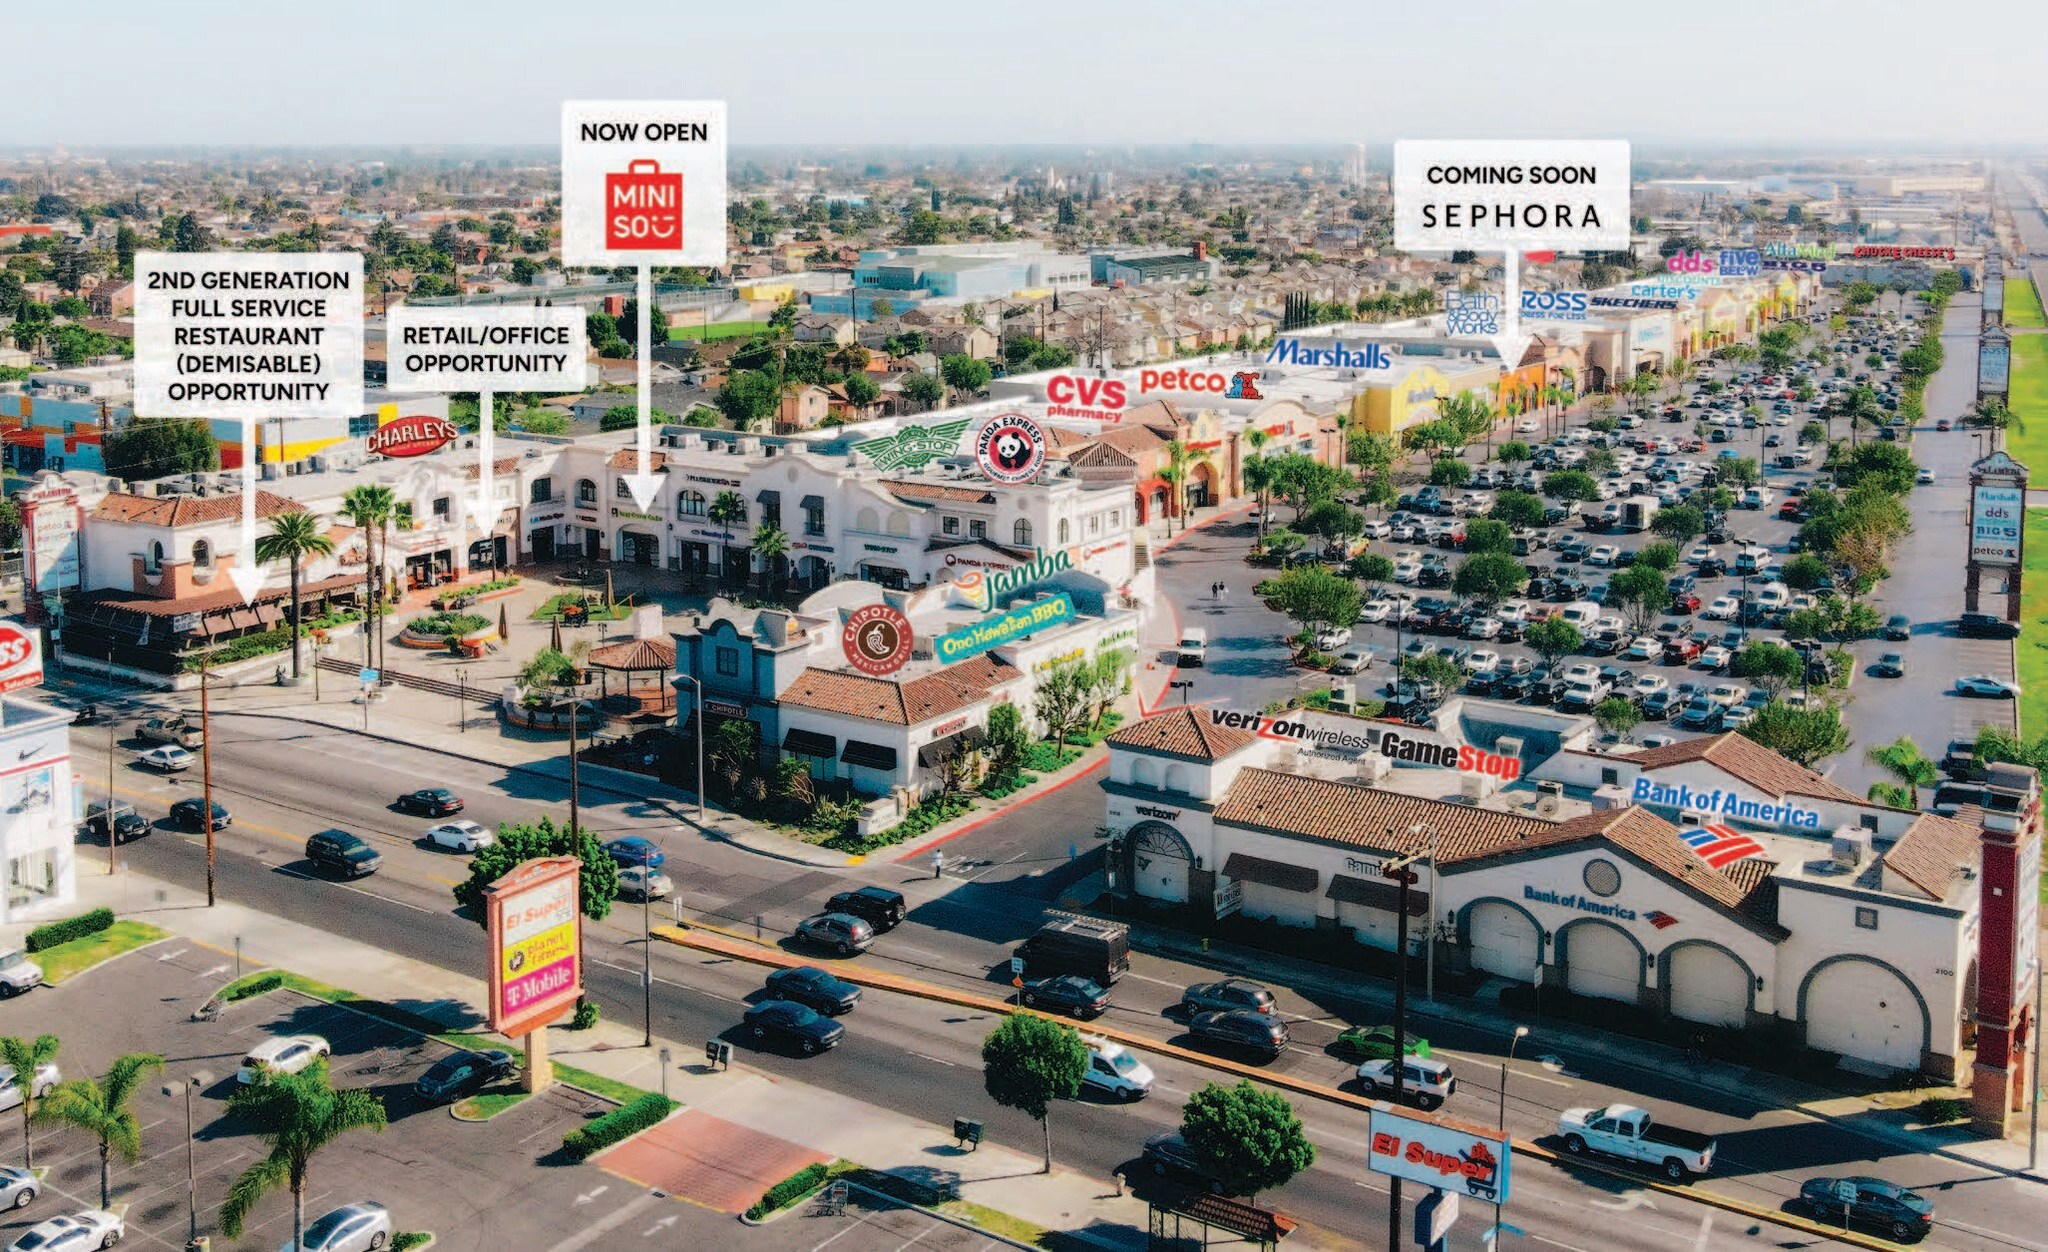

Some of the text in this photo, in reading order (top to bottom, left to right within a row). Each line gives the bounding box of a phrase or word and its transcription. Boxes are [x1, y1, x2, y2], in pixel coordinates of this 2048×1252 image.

[1976, 526, 2018, 537] BIG 5
[1973, 545, 2005, 556] petco
[957, 558, 981, 568] PANDA
[711, 704, 745, 716] CHIPOTLE
[1134, 804, 1178, 822] verizon
[1523, 884, 1637, 921] Bank of America
[506, 911, 522, 930] El
[527, 932, 563, 959] planet
[1371, 1131, 1494, 1181] El Super
